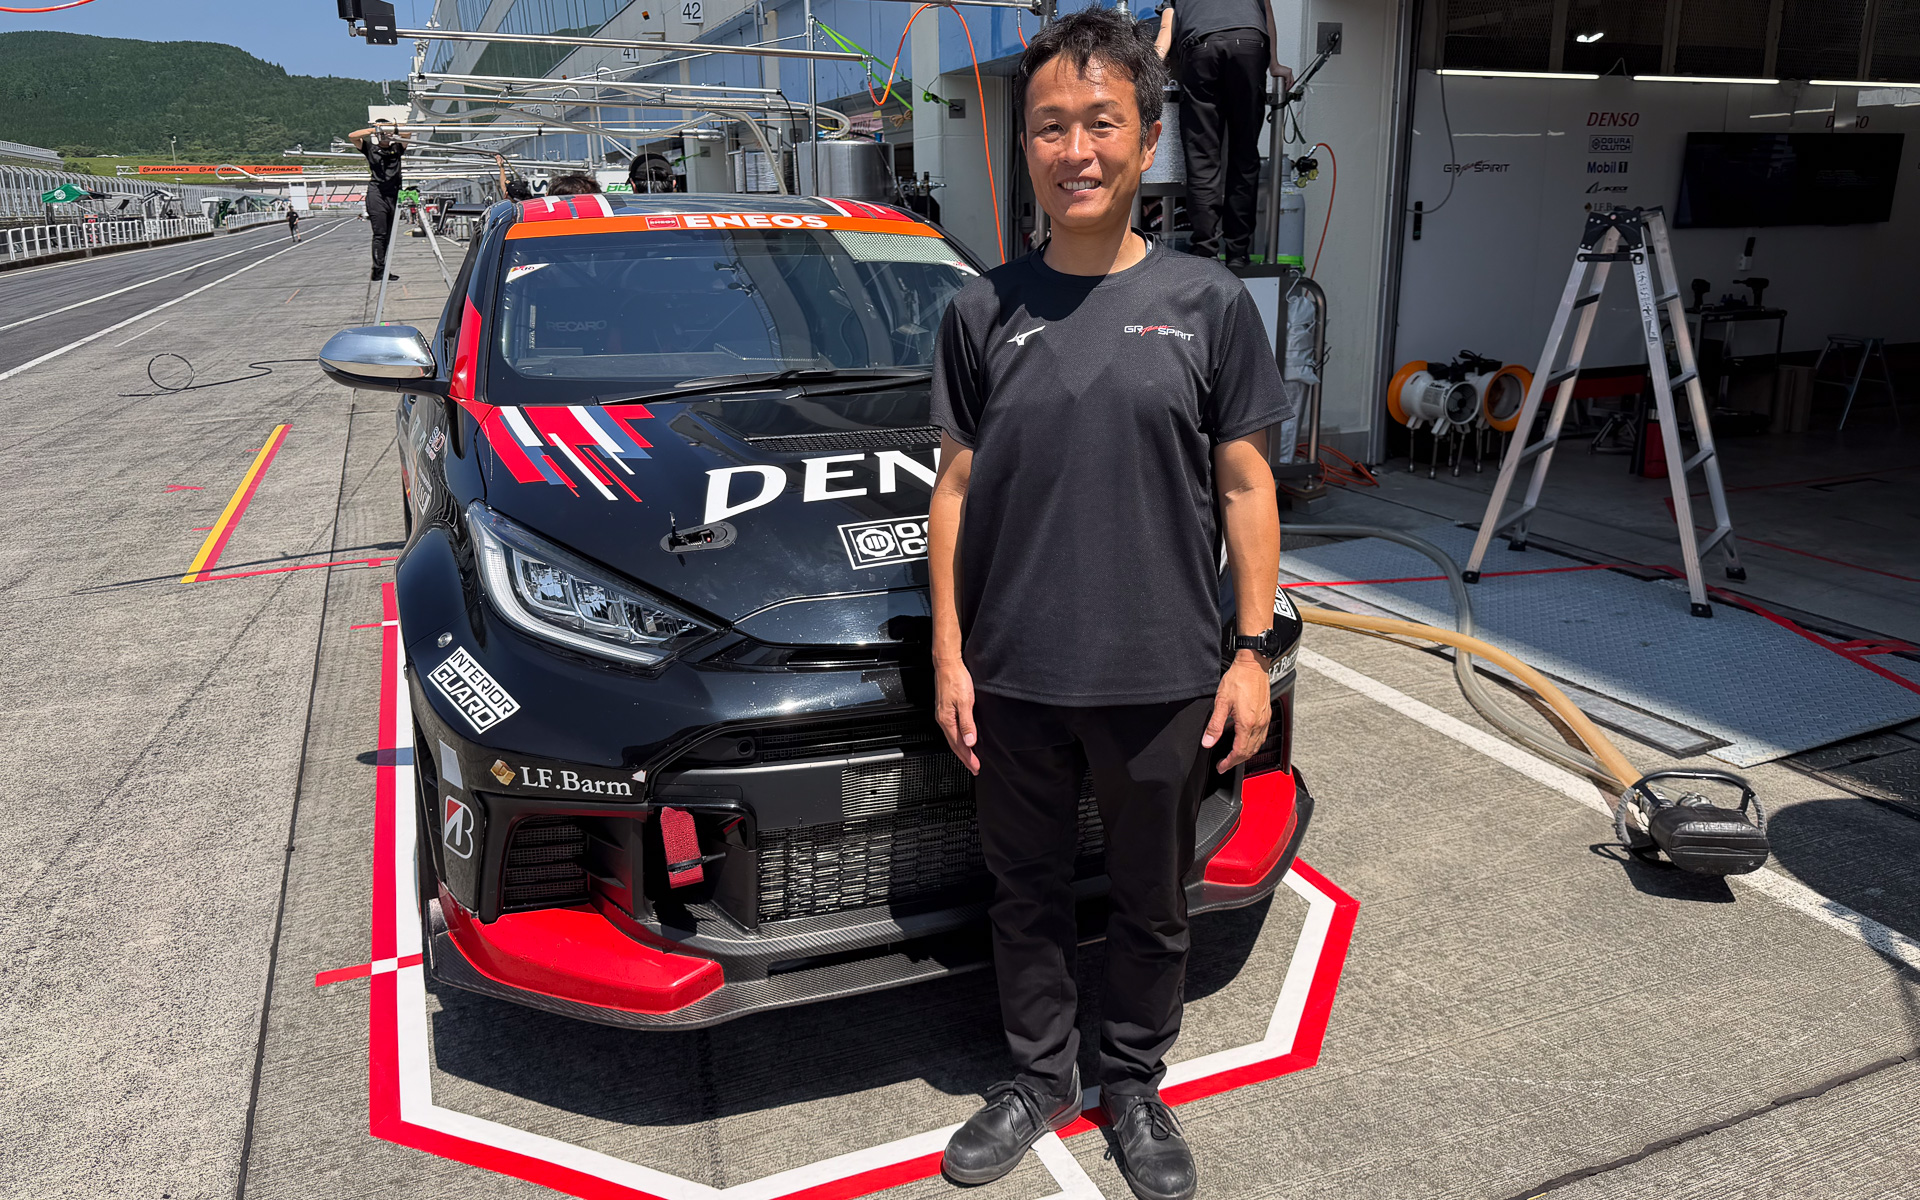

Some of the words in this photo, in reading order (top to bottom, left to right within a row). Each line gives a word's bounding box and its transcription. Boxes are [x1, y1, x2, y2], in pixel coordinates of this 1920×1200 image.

[682, 2, 702, 20] 42
[622, 47, 637, 60] 41
[1586, 111, 1640, 127] DENSO
[1473, 163, 1511, 173] SPIRIT
[1586, 161, 1617, 174] Mobil
[1618, 161, 1629, 174] 1
[682, 214, 828, 229] ENEOS
[545, 319, 608, 332] RECARO
[1124, 325, 1143, 333] GR
[1157, 327, 1195, 341] SPIRIT
[704, 447, 942, 526] DEN
[450, 650, 515, 716] INTERIOR
[432, 663, 497, 728] GUARD
[519, 765, 633, 797] LF.Barm
